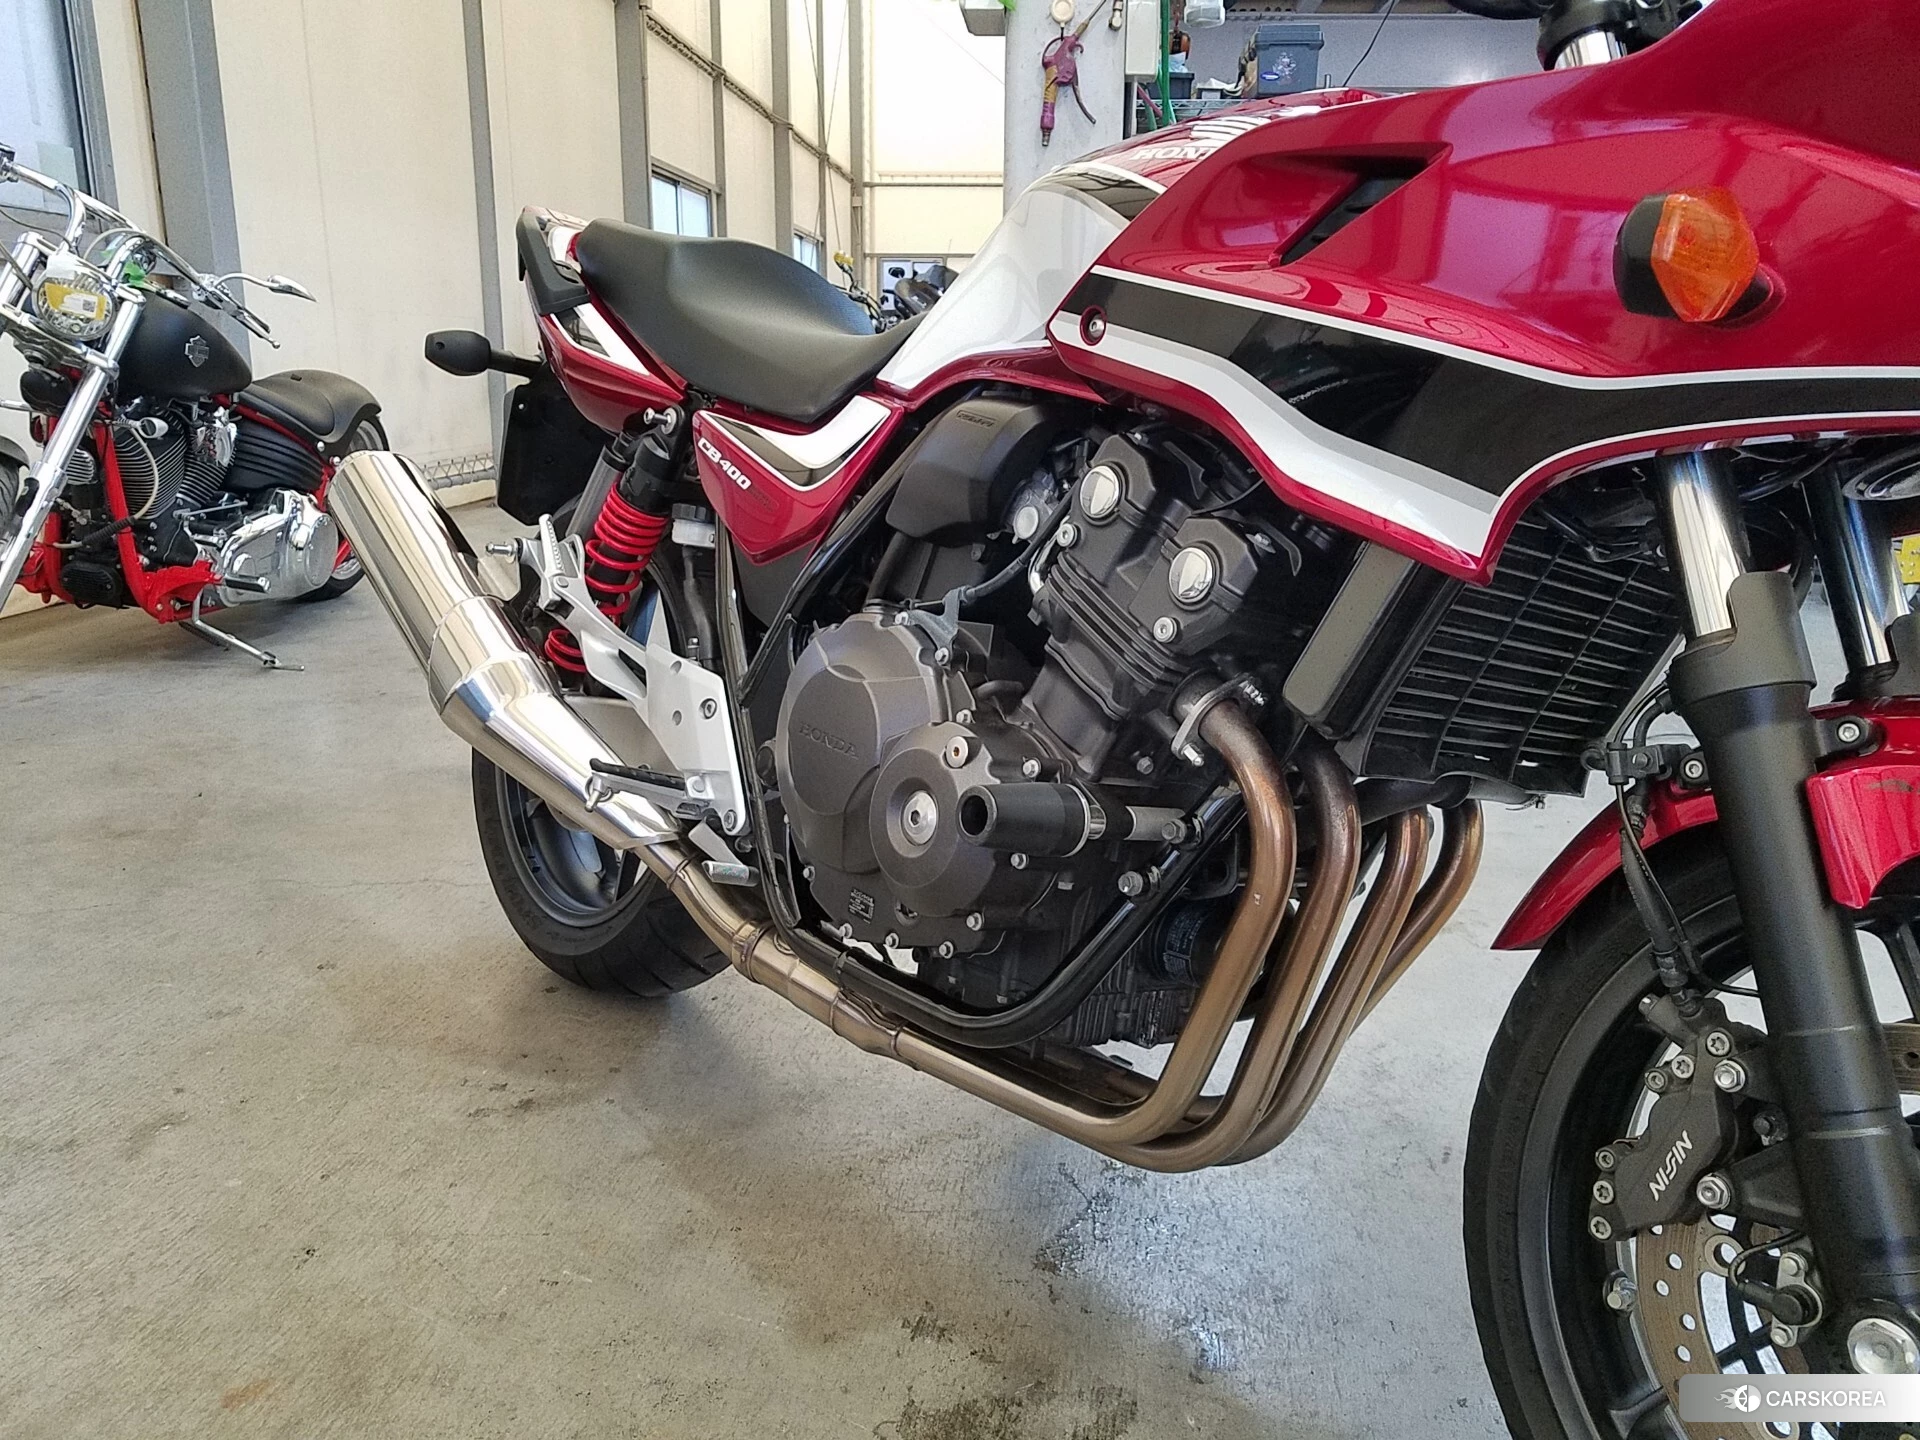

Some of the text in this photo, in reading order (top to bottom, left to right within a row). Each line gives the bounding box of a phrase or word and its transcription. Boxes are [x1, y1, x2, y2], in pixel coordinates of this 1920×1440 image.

[697, 437, 752, 490] CB400
[799, 722, 860, 760] HONDA
[1649, 1129, 1693, 1202] NISSIN
